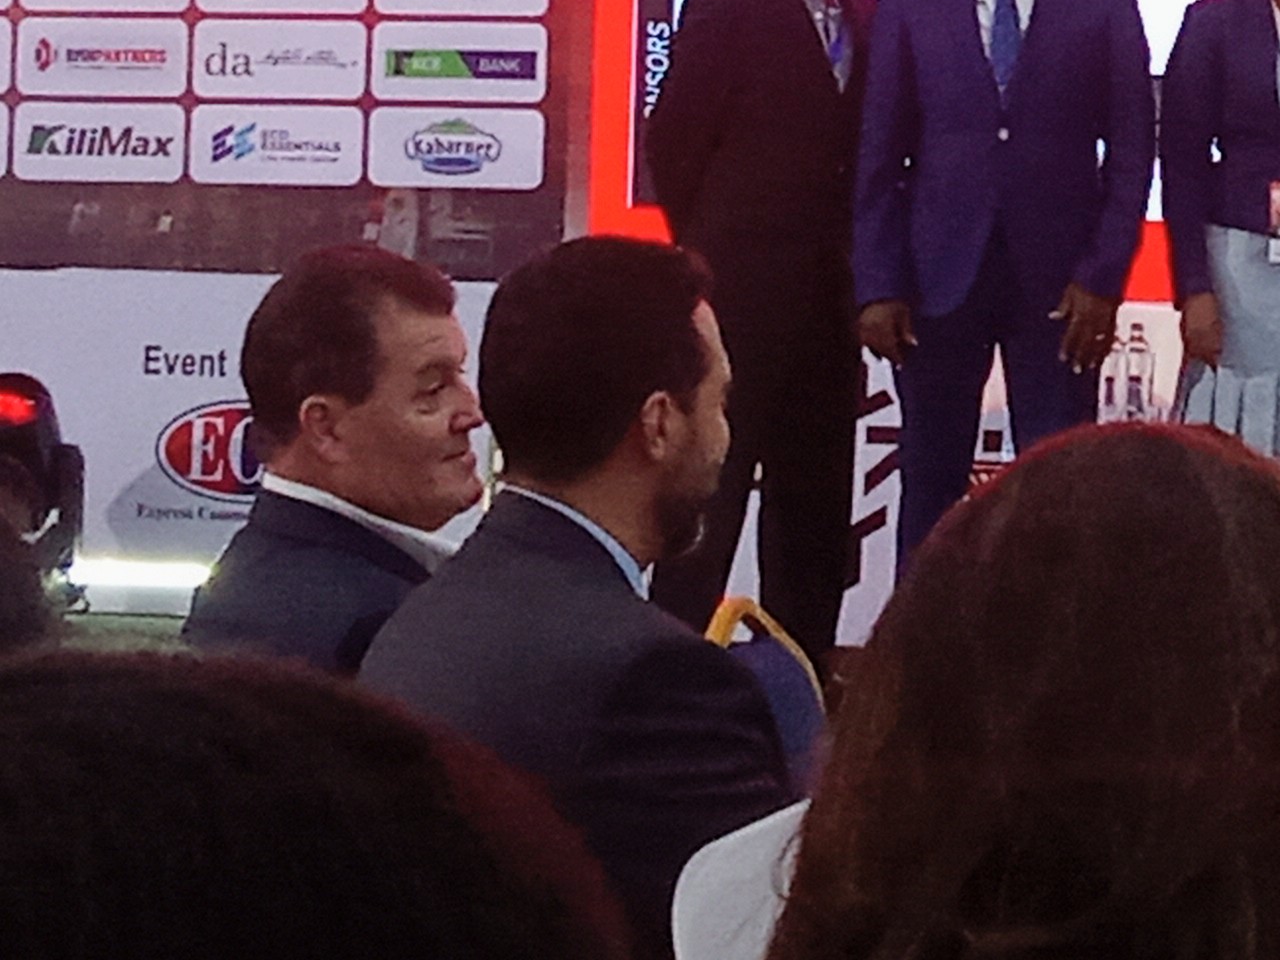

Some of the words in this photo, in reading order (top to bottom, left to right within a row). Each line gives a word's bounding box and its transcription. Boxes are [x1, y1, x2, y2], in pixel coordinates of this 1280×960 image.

[205, 42, 255, 78] da
[25, 124, 175, 157] KiliMax
[143, 344, 228, 377] Event
